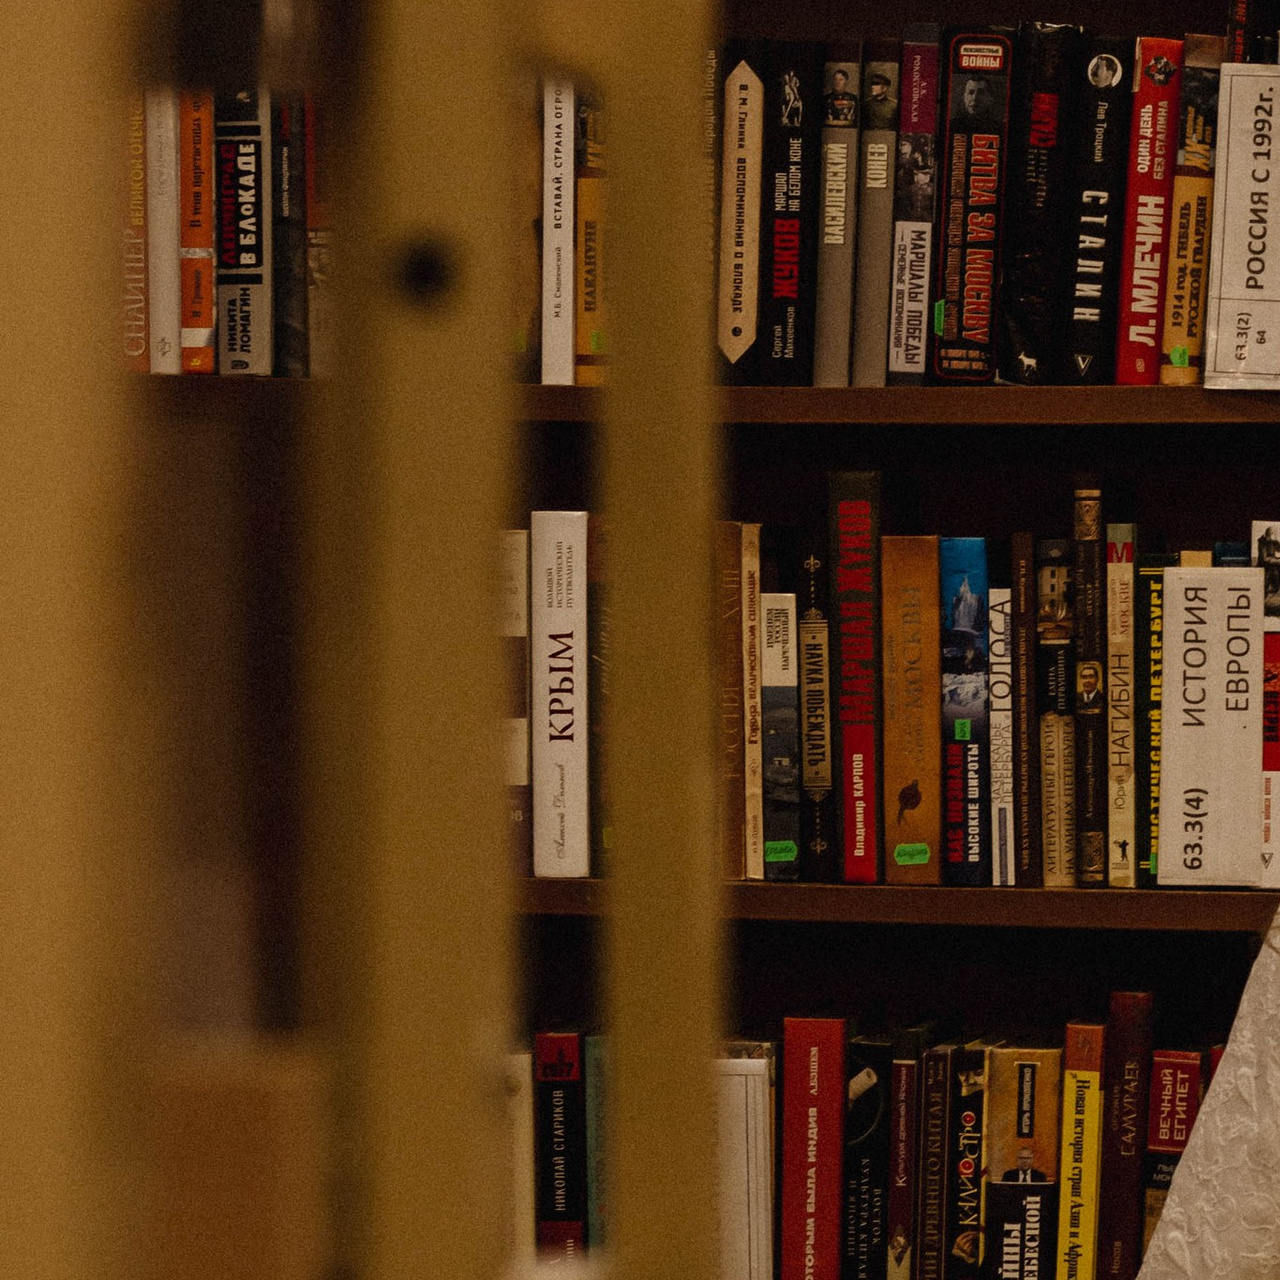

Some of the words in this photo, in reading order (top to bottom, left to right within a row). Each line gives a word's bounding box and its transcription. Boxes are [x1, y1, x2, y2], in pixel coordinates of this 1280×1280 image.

[553, 123, 564, 168] СТРАНА
[1138, 104, 1153, 138] ДЕНЬ
[1155, 100, 1169, 155] СТАЛИНА
[1253, 86, 1275, 161] 1992г.
[789, 137, 802, 161] КОНЕ
[867, 143, 888, 188] КОНЕВ
[969, 134, 1000, 206] БИТВА
[1136, 140, 1151, 173] ОДИН
[1153, 159, 1166, 179] БЕЗ
[1252, 169, 1270, 183] С
[775, 171, 787, 211] МАРШАЛ
[789, 164, 801, 196] БЕЛОМ
[789, 199, 800, 211] НА
[823, 143, 848, 244] ВАСИЛЕВСКИЙ
[967, 212, 995, 240] ЗА
[1131, 195, 1165, 312] МЛЕЧИН
[1246, 191, 1269, 289] РОССИЯ
[240, 254, 257, 265] В
[773, 219, 800, 299] ЖУКОВ
[907, 230, 924, 303] МАРШАЛЫ
[1072, 190, 1109, 322] СТАЛИН
[238, 287, 251, 353] ЛОМАГИН
[962, 248, 992, 344] МОСКВУ
[225, 298, 237, 352] НИКИТА
[905, 310, 922, 364] ПОБЕДЫ
[1129, 319, 1156, 347] Л.
[1183, 587, 1207, 726] ИСТОРИЯ
[1226, 587, 1251, 711] ЕВРОПЫ
[547, 630, 574, 743] КРЫМ
[1110, 653, 1131, 767] НАГИБИН
[967, 743, 979, 798] ШИРОТЫ
[967, 802, 979, 862] ВЫСОКИЕ
[1183, 788, 1209, 870] 63.3(4)
[550, 1089, 564, 1151] СТАРИКОВ
[1158, 1068, 1174, 1140] ВЕЧНЫЙ
[1173, 1070, 1190, 1140] ЕГИПЕТ
[806, 1107, 818, 1162] ИНДИЯ
[551, 1157, 566, 1212] НИКОЛАЙ
[806, 1167, 818, 1212] БЫЛА
